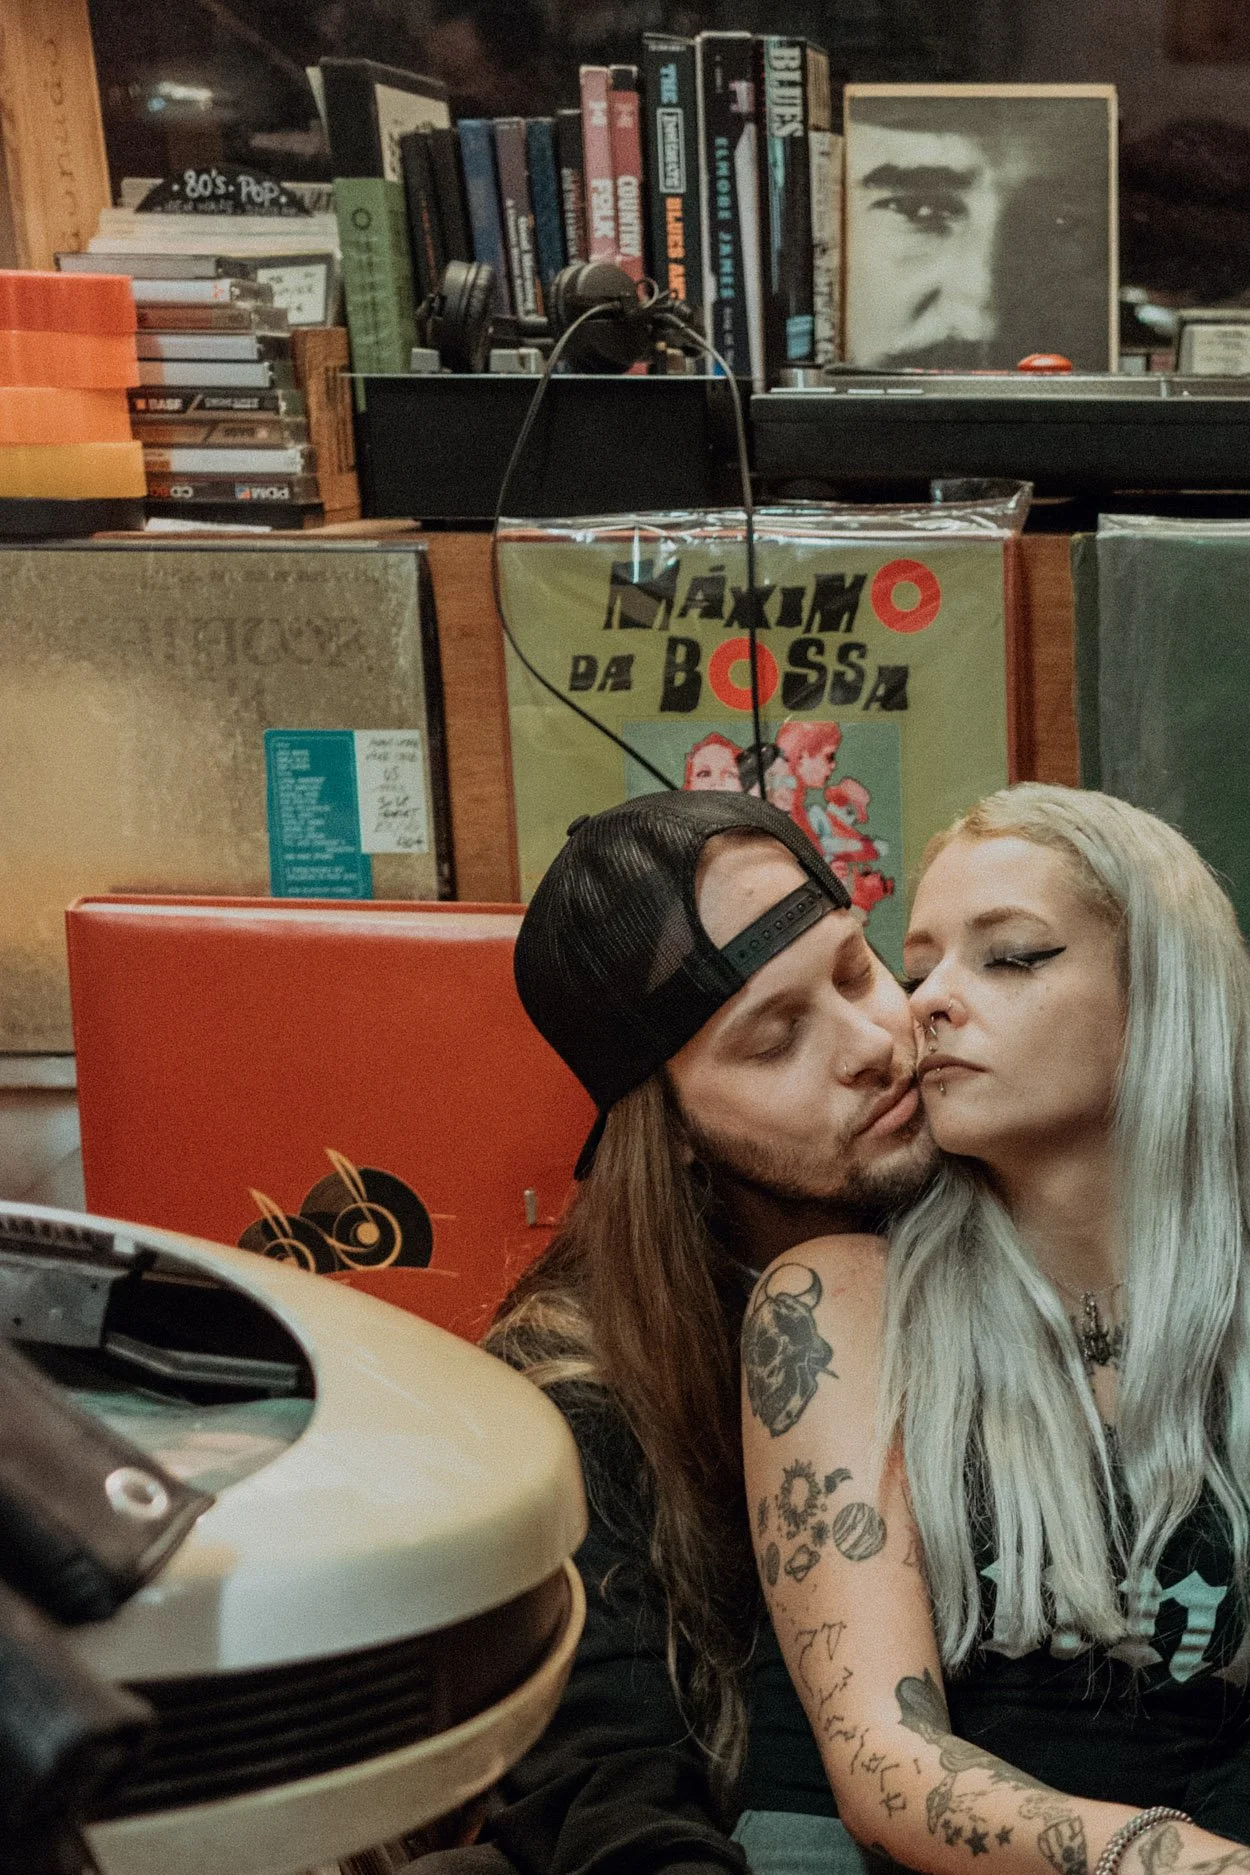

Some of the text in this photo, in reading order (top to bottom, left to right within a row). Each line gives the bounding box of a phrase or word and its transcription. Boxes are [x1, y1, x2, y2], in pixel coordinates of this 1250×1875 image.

[659, 63, 678, 104] THE
[771, 46, 804, 138] BLUES
[184, 168, 227, 199] 80's
[591, 178, 616, 239] FOLK
[715, 136, 732, 220] ELMORE
[616, 175, 642, 257] COUNTRY
[666, 197, 686, 259] BLUES
[719, 231, 736, 300] JAMES
[251, 485, 290, 500] PDM
[603, 558, 942, 634] MÁXIMO
[569, 635, 910, 713] DA BOSSA
